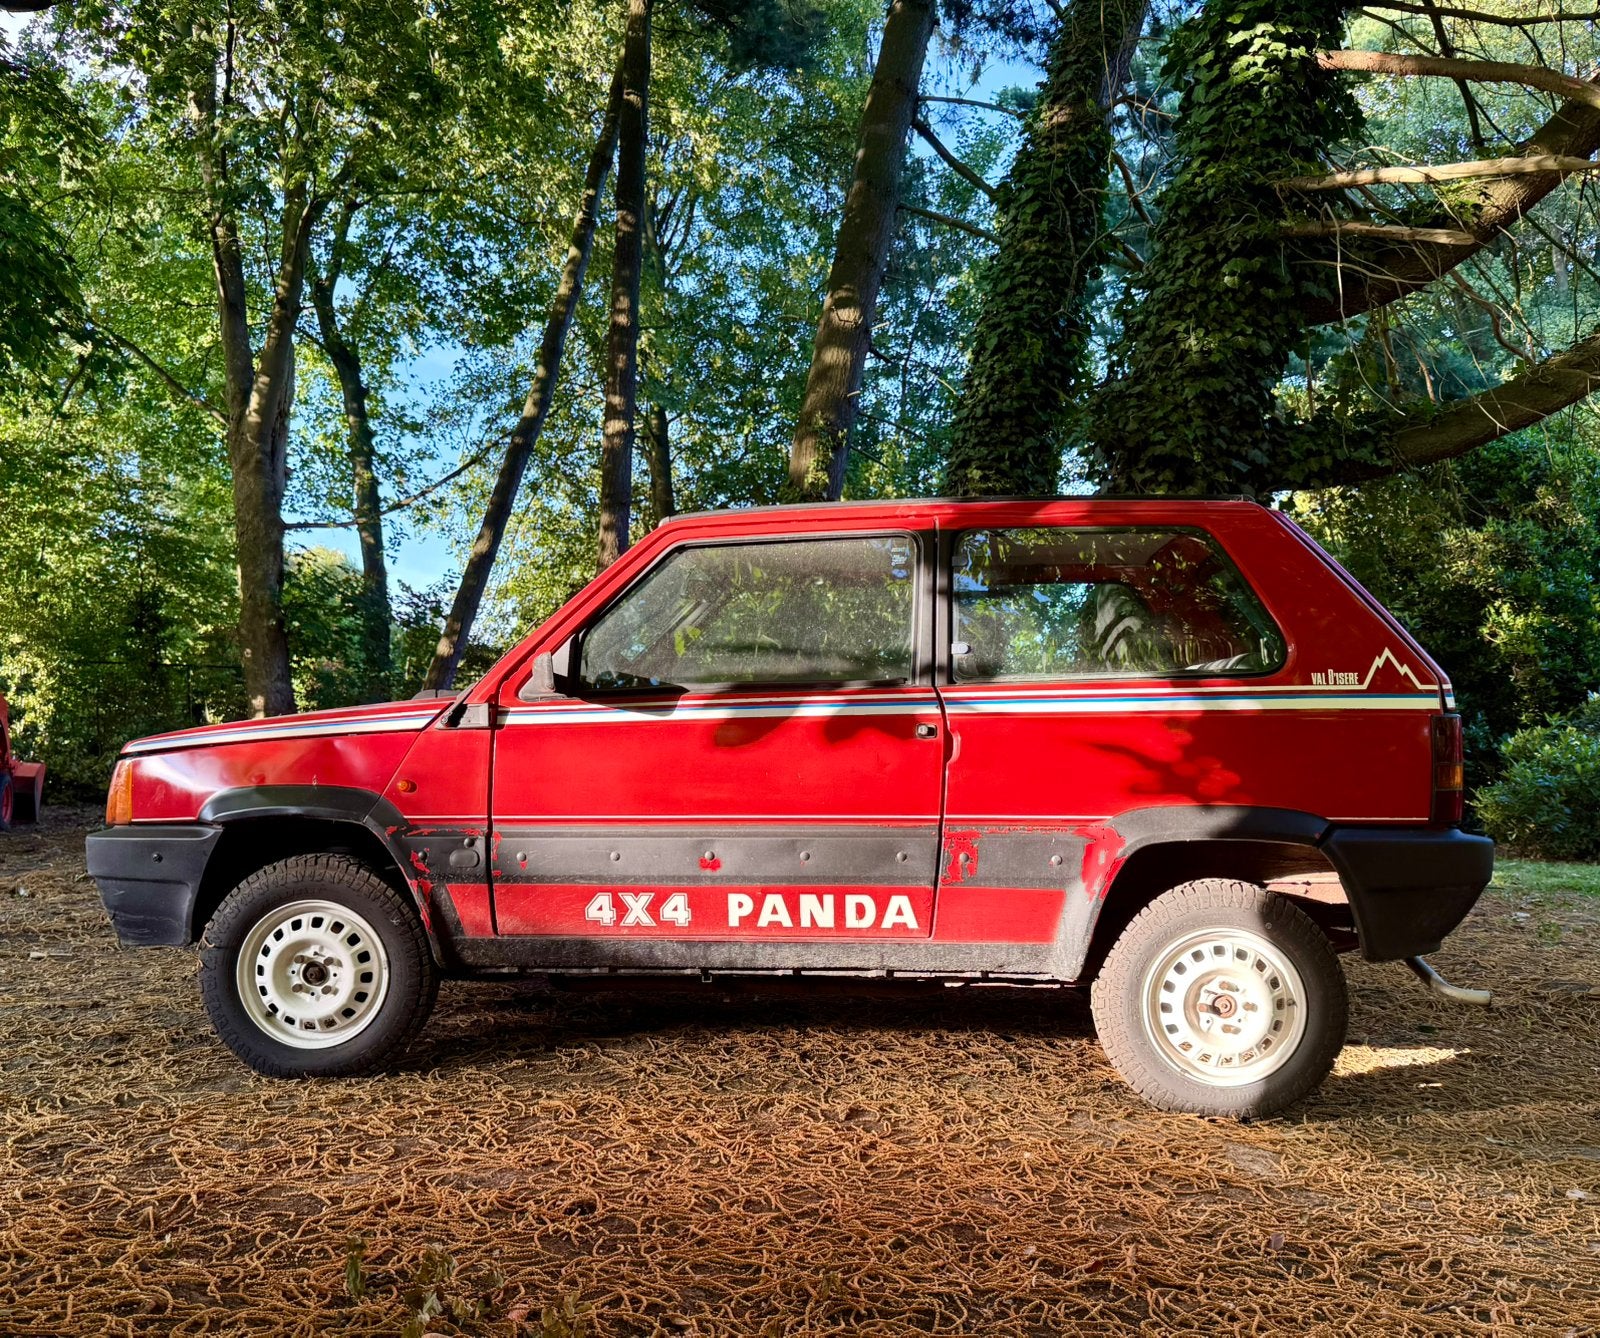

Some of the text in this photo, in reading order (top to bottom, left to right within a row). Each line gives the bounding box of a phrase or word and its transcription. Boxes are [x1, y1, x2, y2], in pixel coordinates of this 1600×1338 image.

[1311, 672, 1327, 685] VAL
[585, 892, 919, 929] 4X4 PANDA
